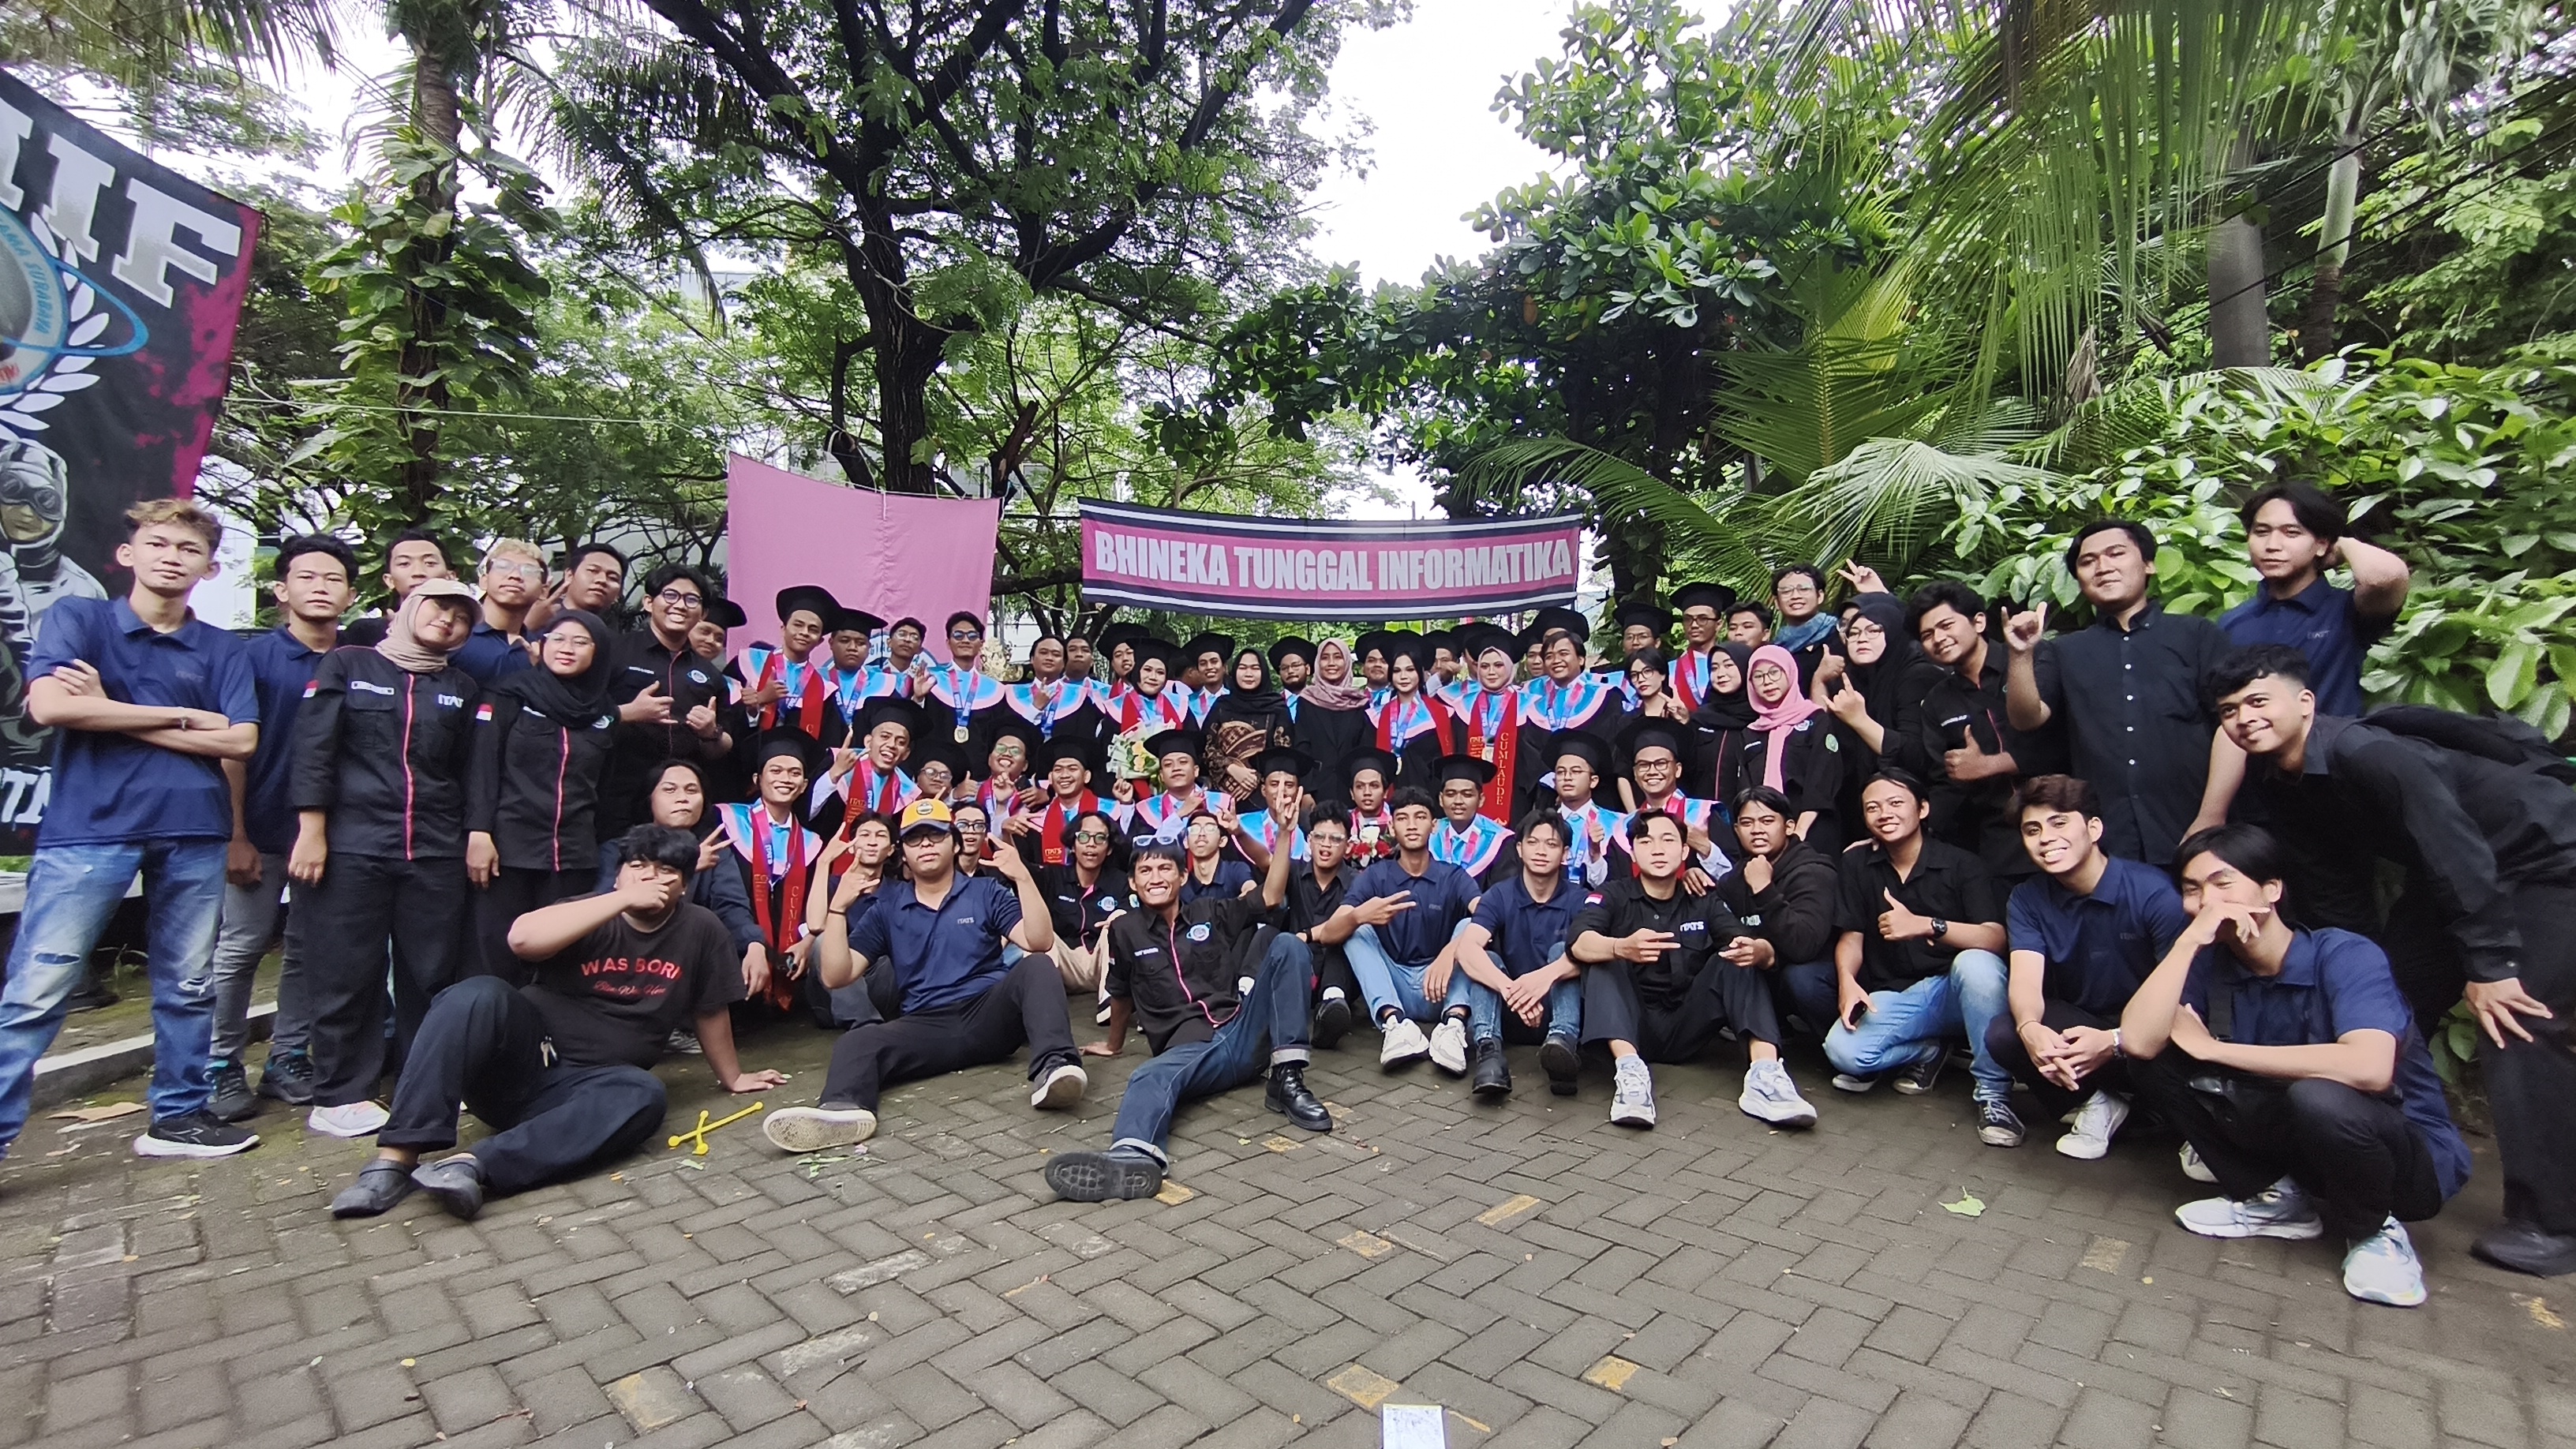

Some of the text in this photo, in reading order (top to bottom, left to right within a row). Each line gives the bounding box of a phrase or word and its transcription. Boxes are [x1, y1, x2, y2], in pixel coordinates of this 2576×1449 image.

[1094, 530, 1572, 591] BHINEKA TUNGGAL INFORMATIKA
[1496, 732, 1509, 806] CUMLAUDE
[957, 915, 975, 925] ITATS
[581, 957, 628, 976] WAS
